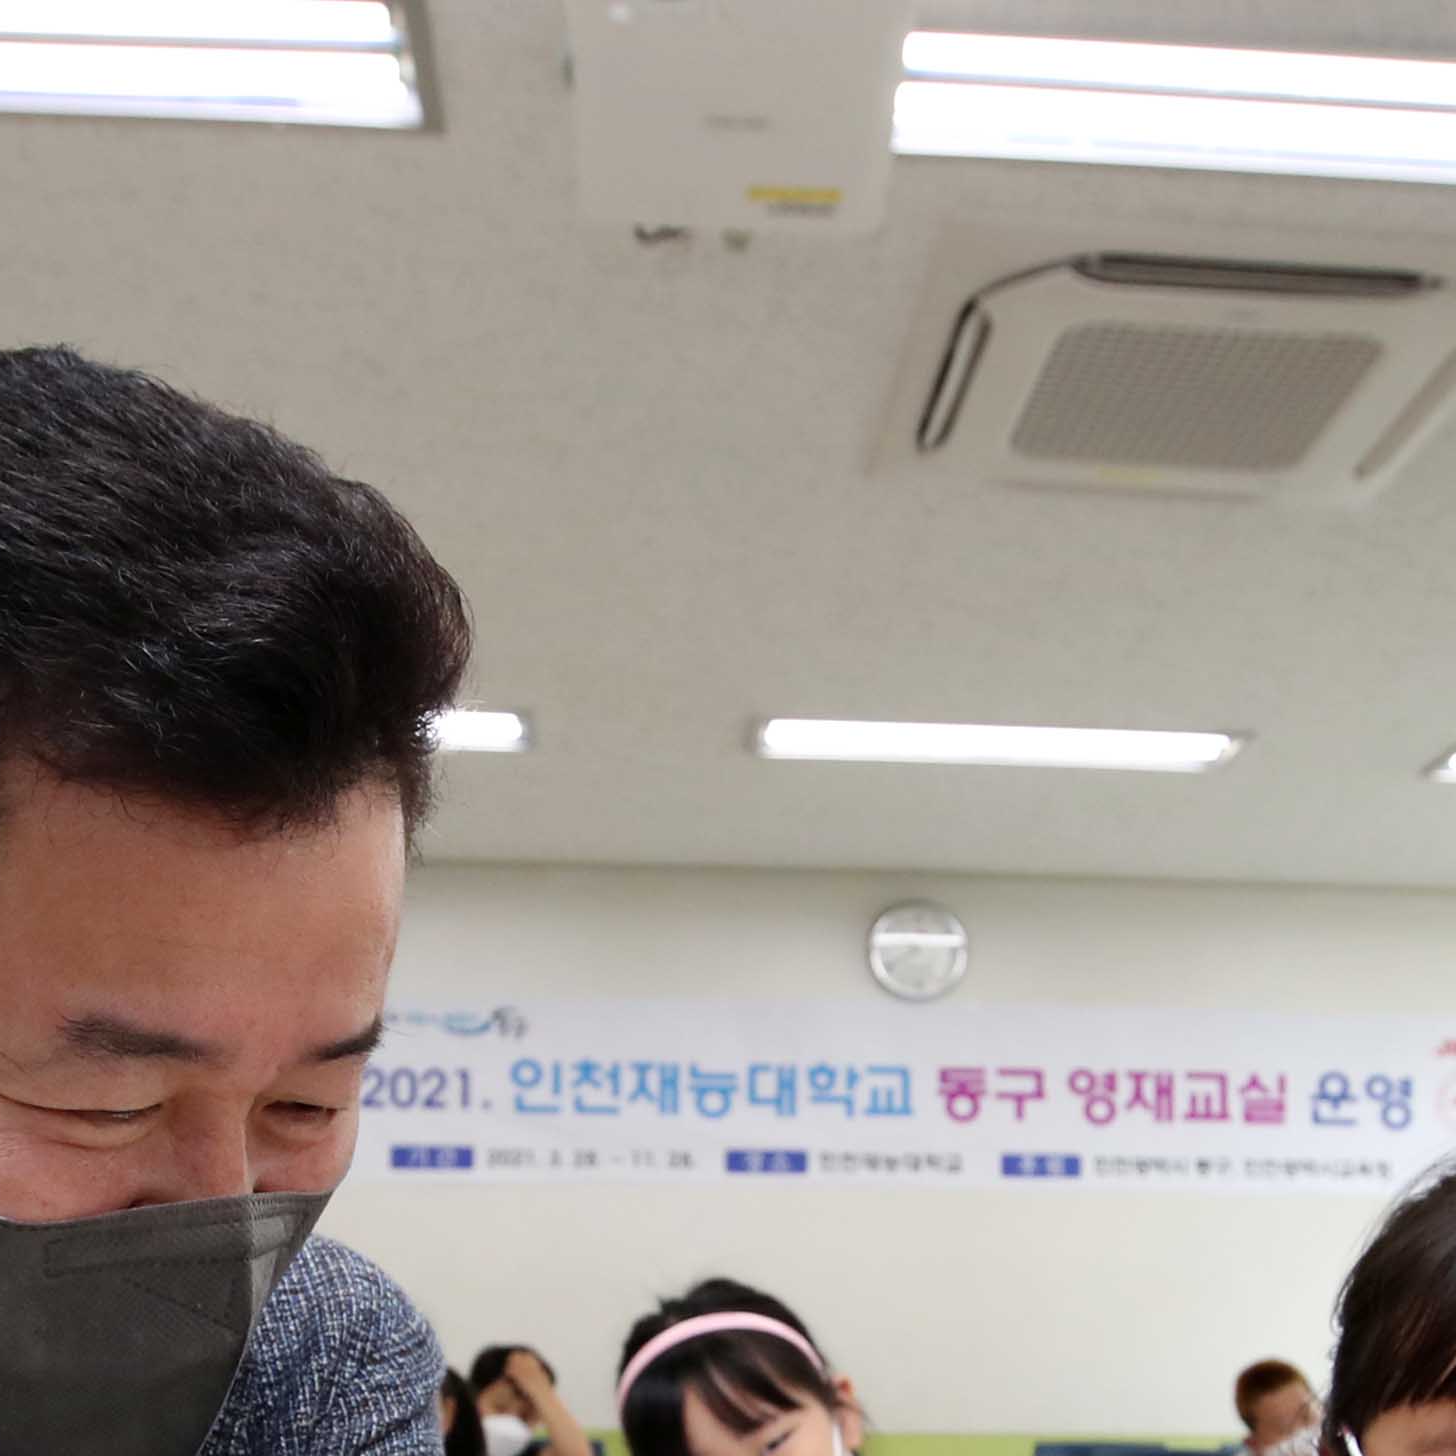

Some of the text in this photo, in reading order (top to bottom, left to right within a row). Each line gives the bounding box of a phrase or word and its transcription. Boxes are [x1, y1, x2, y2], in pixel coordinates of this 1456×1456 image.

[361, 1056, 1413, 1131] 2021. 인천재능대학교 동구 영재교실 운영
